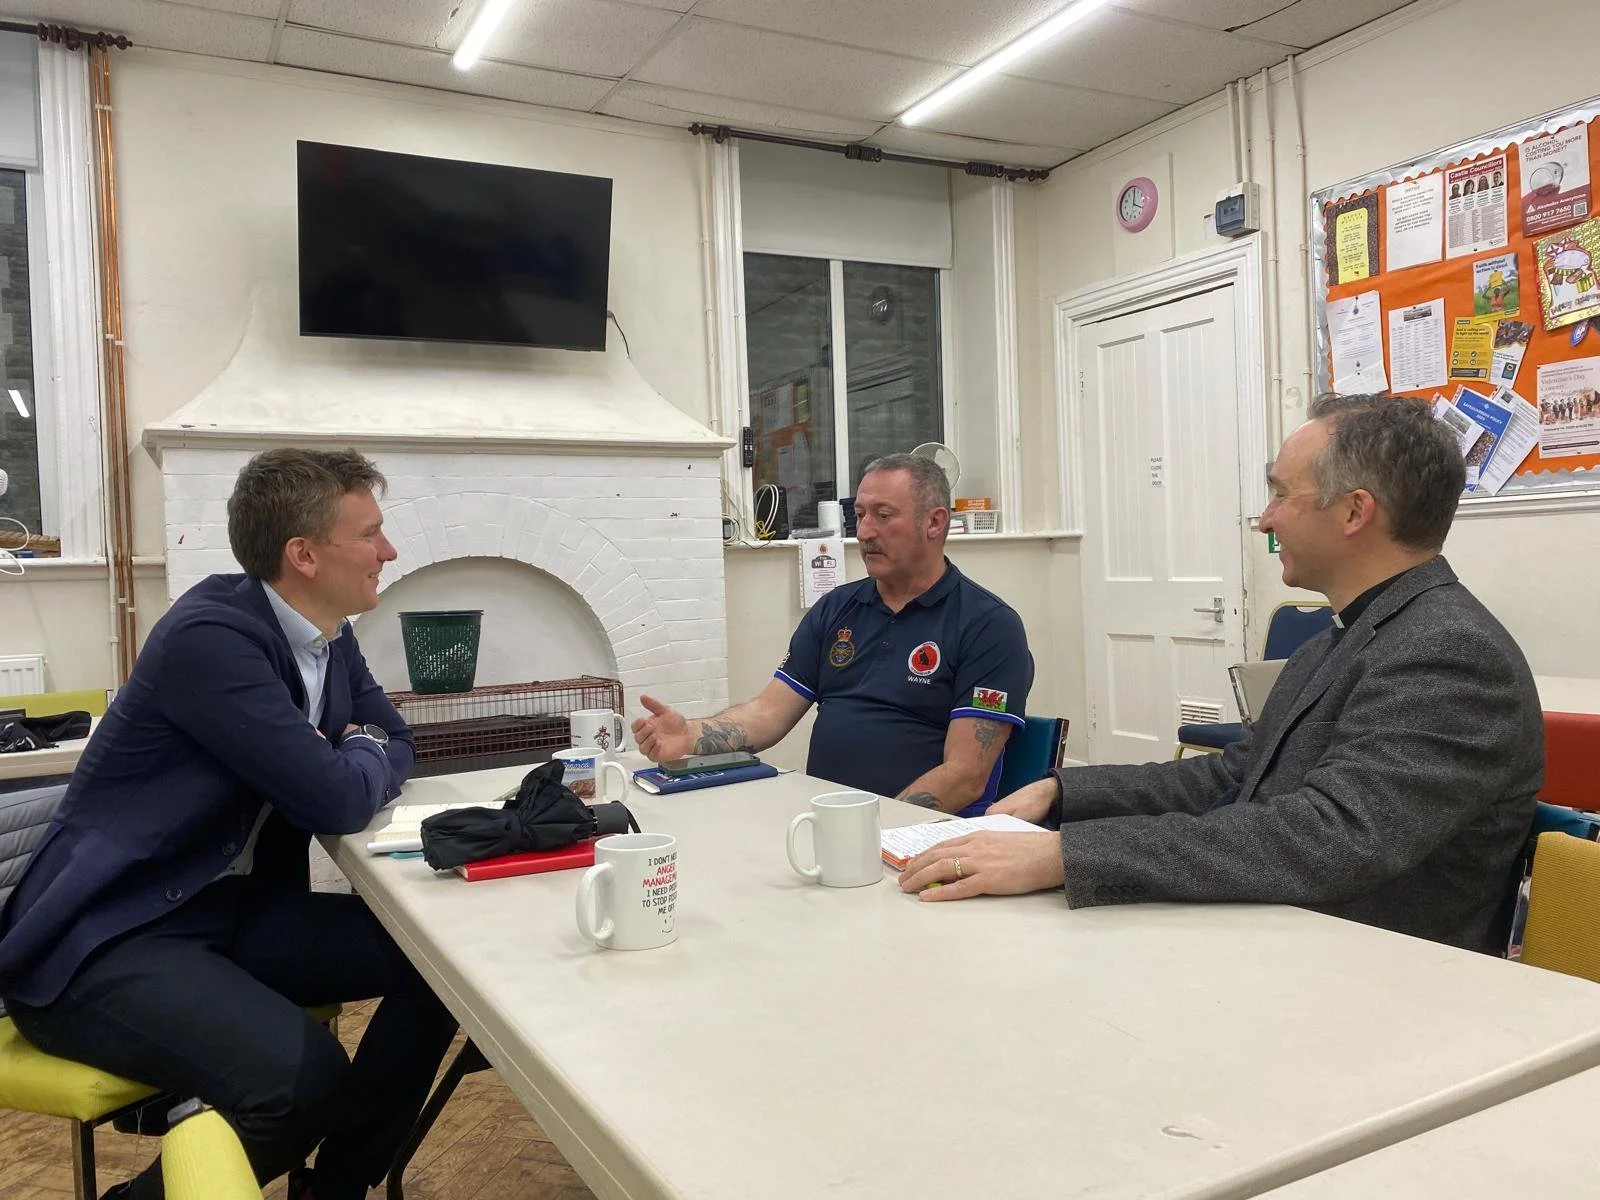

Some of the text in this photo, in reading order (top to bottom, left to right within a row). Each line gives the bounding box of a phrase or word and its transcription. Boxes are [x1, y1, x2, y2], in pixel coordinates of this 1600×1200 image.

[1525, 135, 1582, 157] COSTING YOU MORE
[1526, 145, 1568, 162] THAN MONEY?
[1450, 169, 1469, 179] Castle
[1470, 159, 1503, 173] Councillors
[1526, 214, 1541, 222] 0800
[1555, 205, 1572, 213] 7650
[908, 676, 931, 684] WAYNE
[653, 854, 670, 866] DON'T
[647, 889, 650, 897] I
[652, 886, 668, 897] NEED
[642, 899, 651, 908] TO
[652, 895, 668, 907] STOP
[658, 906, 667, 915] ME
